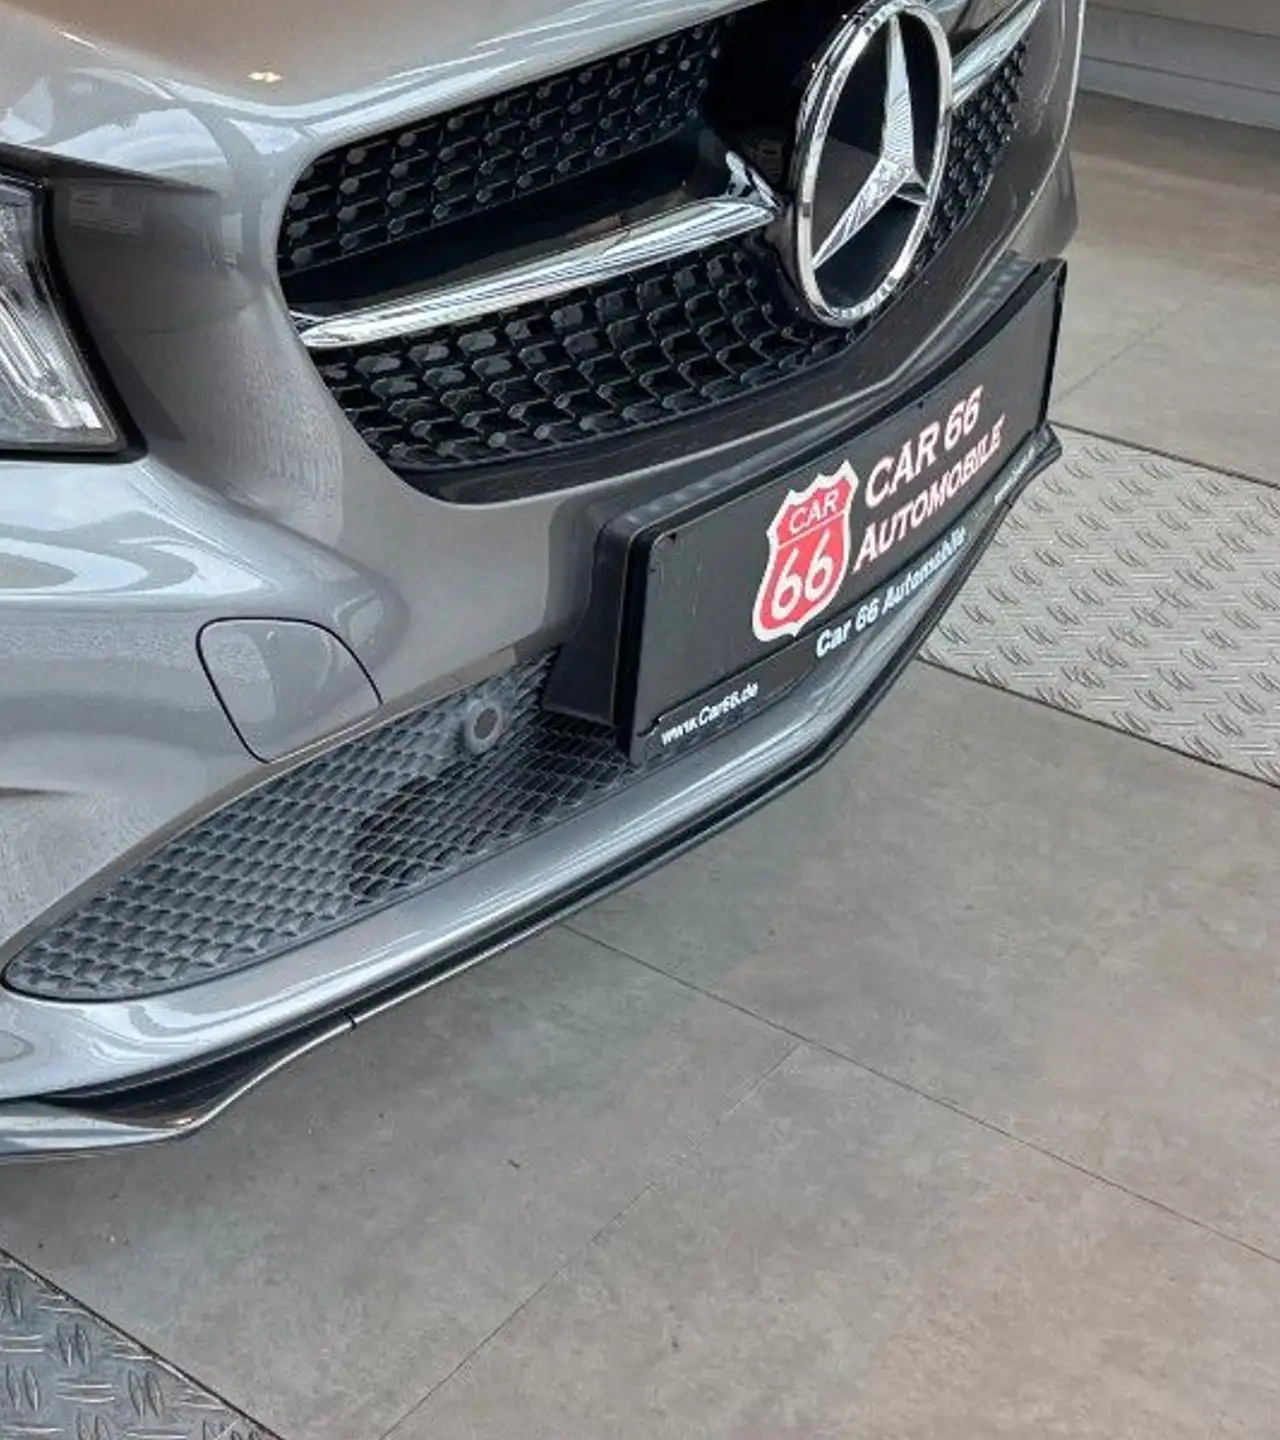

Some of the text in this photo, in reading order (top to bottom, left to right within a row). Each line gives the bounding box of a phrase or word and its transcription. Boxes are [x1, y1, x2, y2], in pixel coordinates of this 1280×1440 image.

[864, 421, 940, 509] CAR
[944, 384, 984, 452] 66
[789, 488, 841, 534] CAR
[852, 412, 1006, 576] AUTOMOBILE
[771, 528, 834, 621] 66
[815, 618, 853, 659] Car
[855, 596, 881, 633] 66
